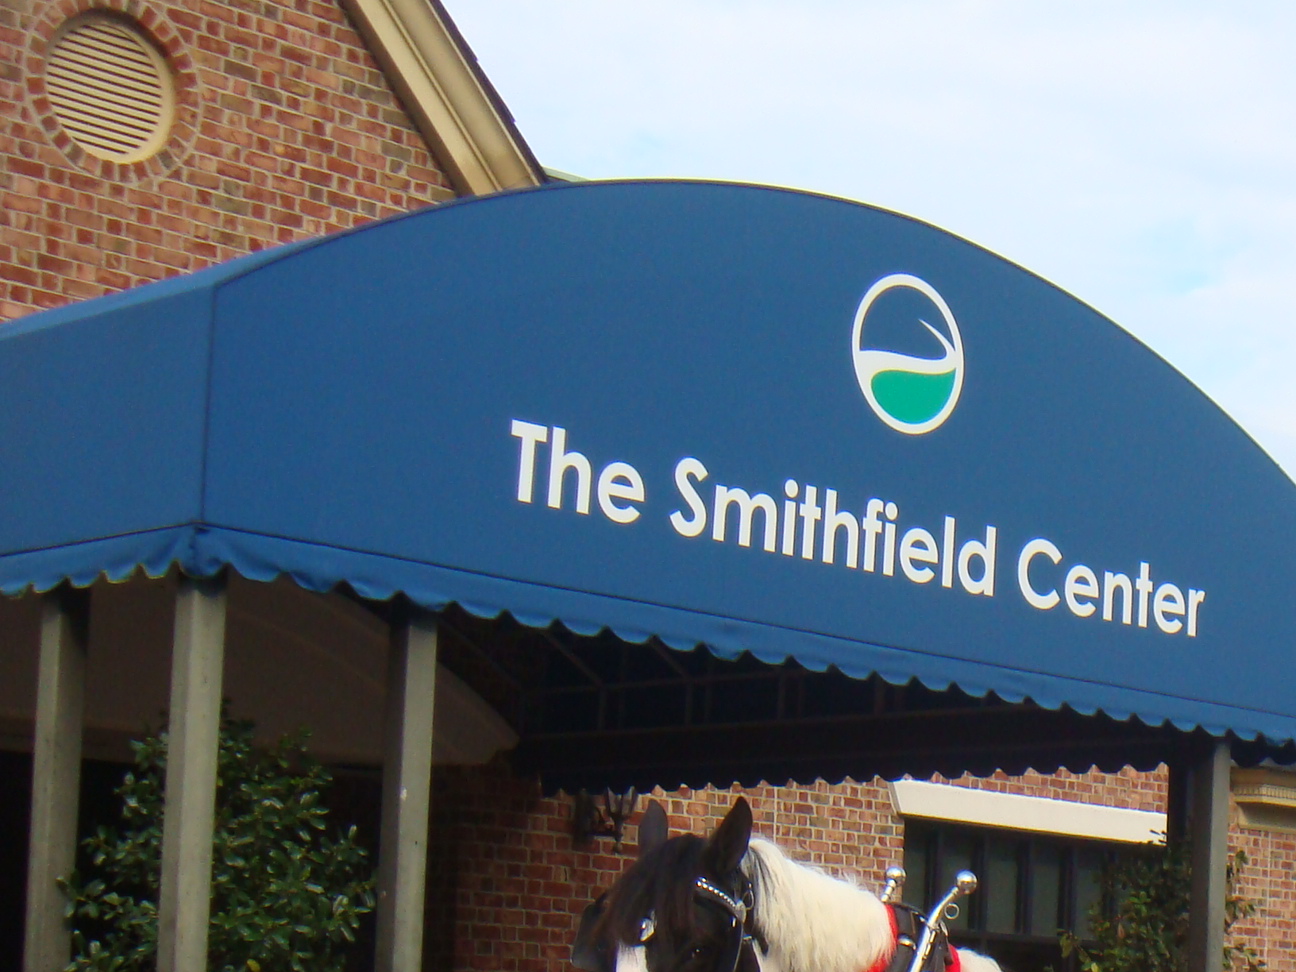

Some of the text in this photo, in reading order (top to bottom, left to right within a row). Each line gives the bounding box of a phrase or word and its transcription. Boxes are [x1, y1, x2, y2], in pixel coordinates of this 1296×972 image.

[511, 418, 1206, 638] The Smithfield Center
